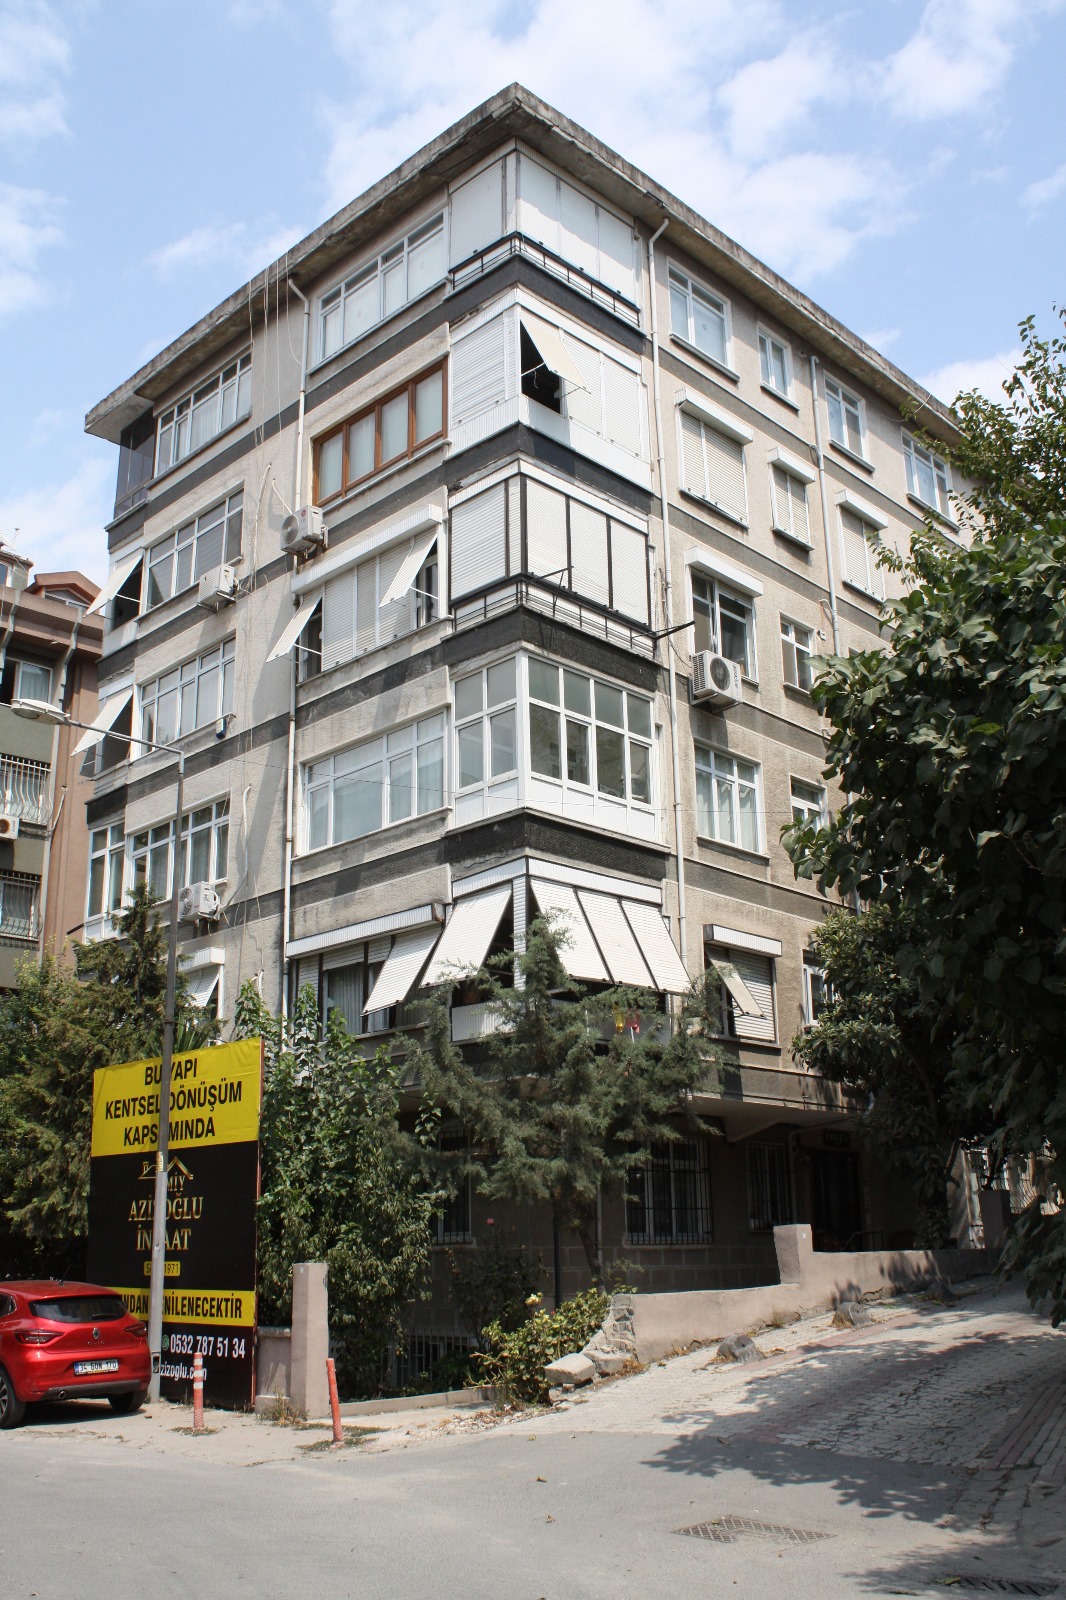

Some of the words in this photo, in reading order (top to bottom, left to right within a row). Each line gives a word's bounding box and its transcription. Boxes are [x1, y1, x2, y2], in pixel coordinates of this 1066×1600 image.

[145, 1064, 162, 1085] BU
[105, 1094, 160, 1120] KENTSEL
[170, 1078, 242, 1111] DÖNÜŞÜM
[123, 1117, 215, 1146] KAPSMINDA
[128, 1192, 203, 1221] AZİOĞLU
[136, 1224, 191, 1251] İNAAT
[162, 1291, 242, 1319] NİLENECEKTİR
[170, 1333, 193, 1354] 0532
[196, 1335, 214, 1356] 787
[217, 1336, 229, 1357] 51
[232, 1337, 246, 1358] 34
